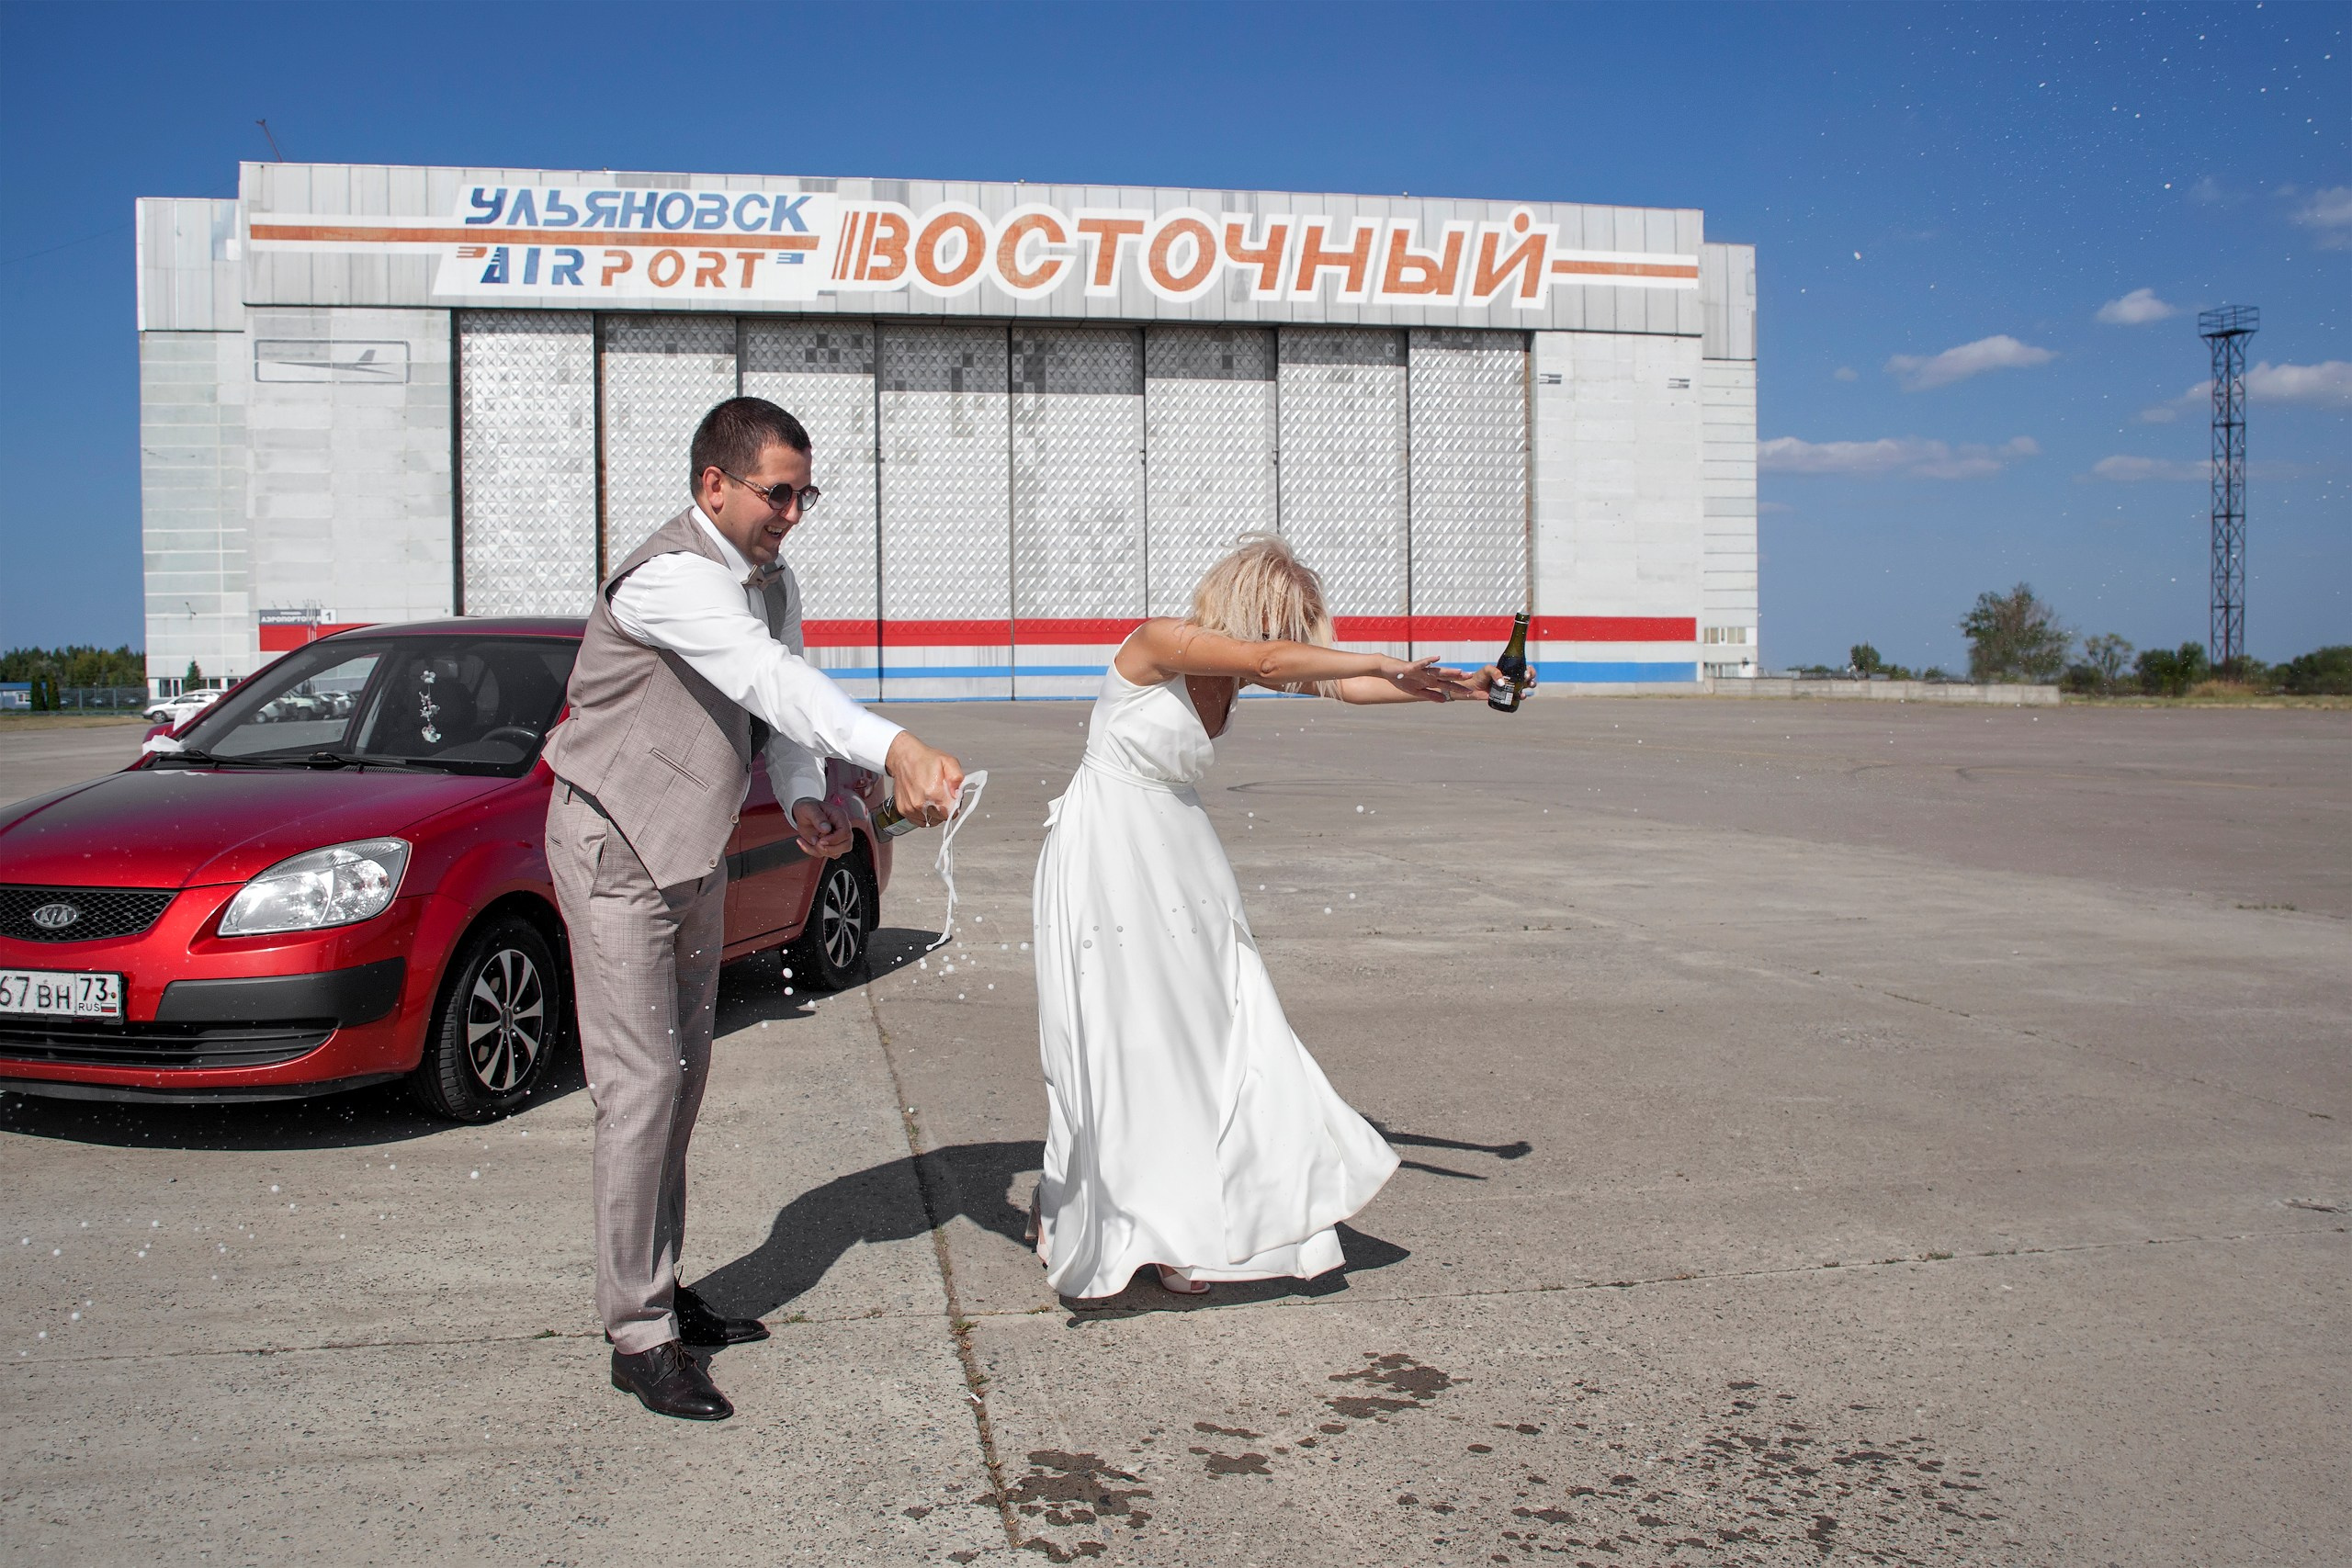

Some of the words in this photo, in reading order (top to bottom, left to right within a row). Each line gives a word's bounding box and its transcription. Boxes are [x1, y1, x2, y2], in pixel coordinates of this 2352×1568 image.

[465, 187, 815, 232] УЛЬЯНОВСК
[831, 210, 1548, 299] ВОСТОЧНЫЙ
[39, 908, 70, 922] KIA
[80, 977, 107, 1001] 73
[78, 1002, 100, 1012] RUS
